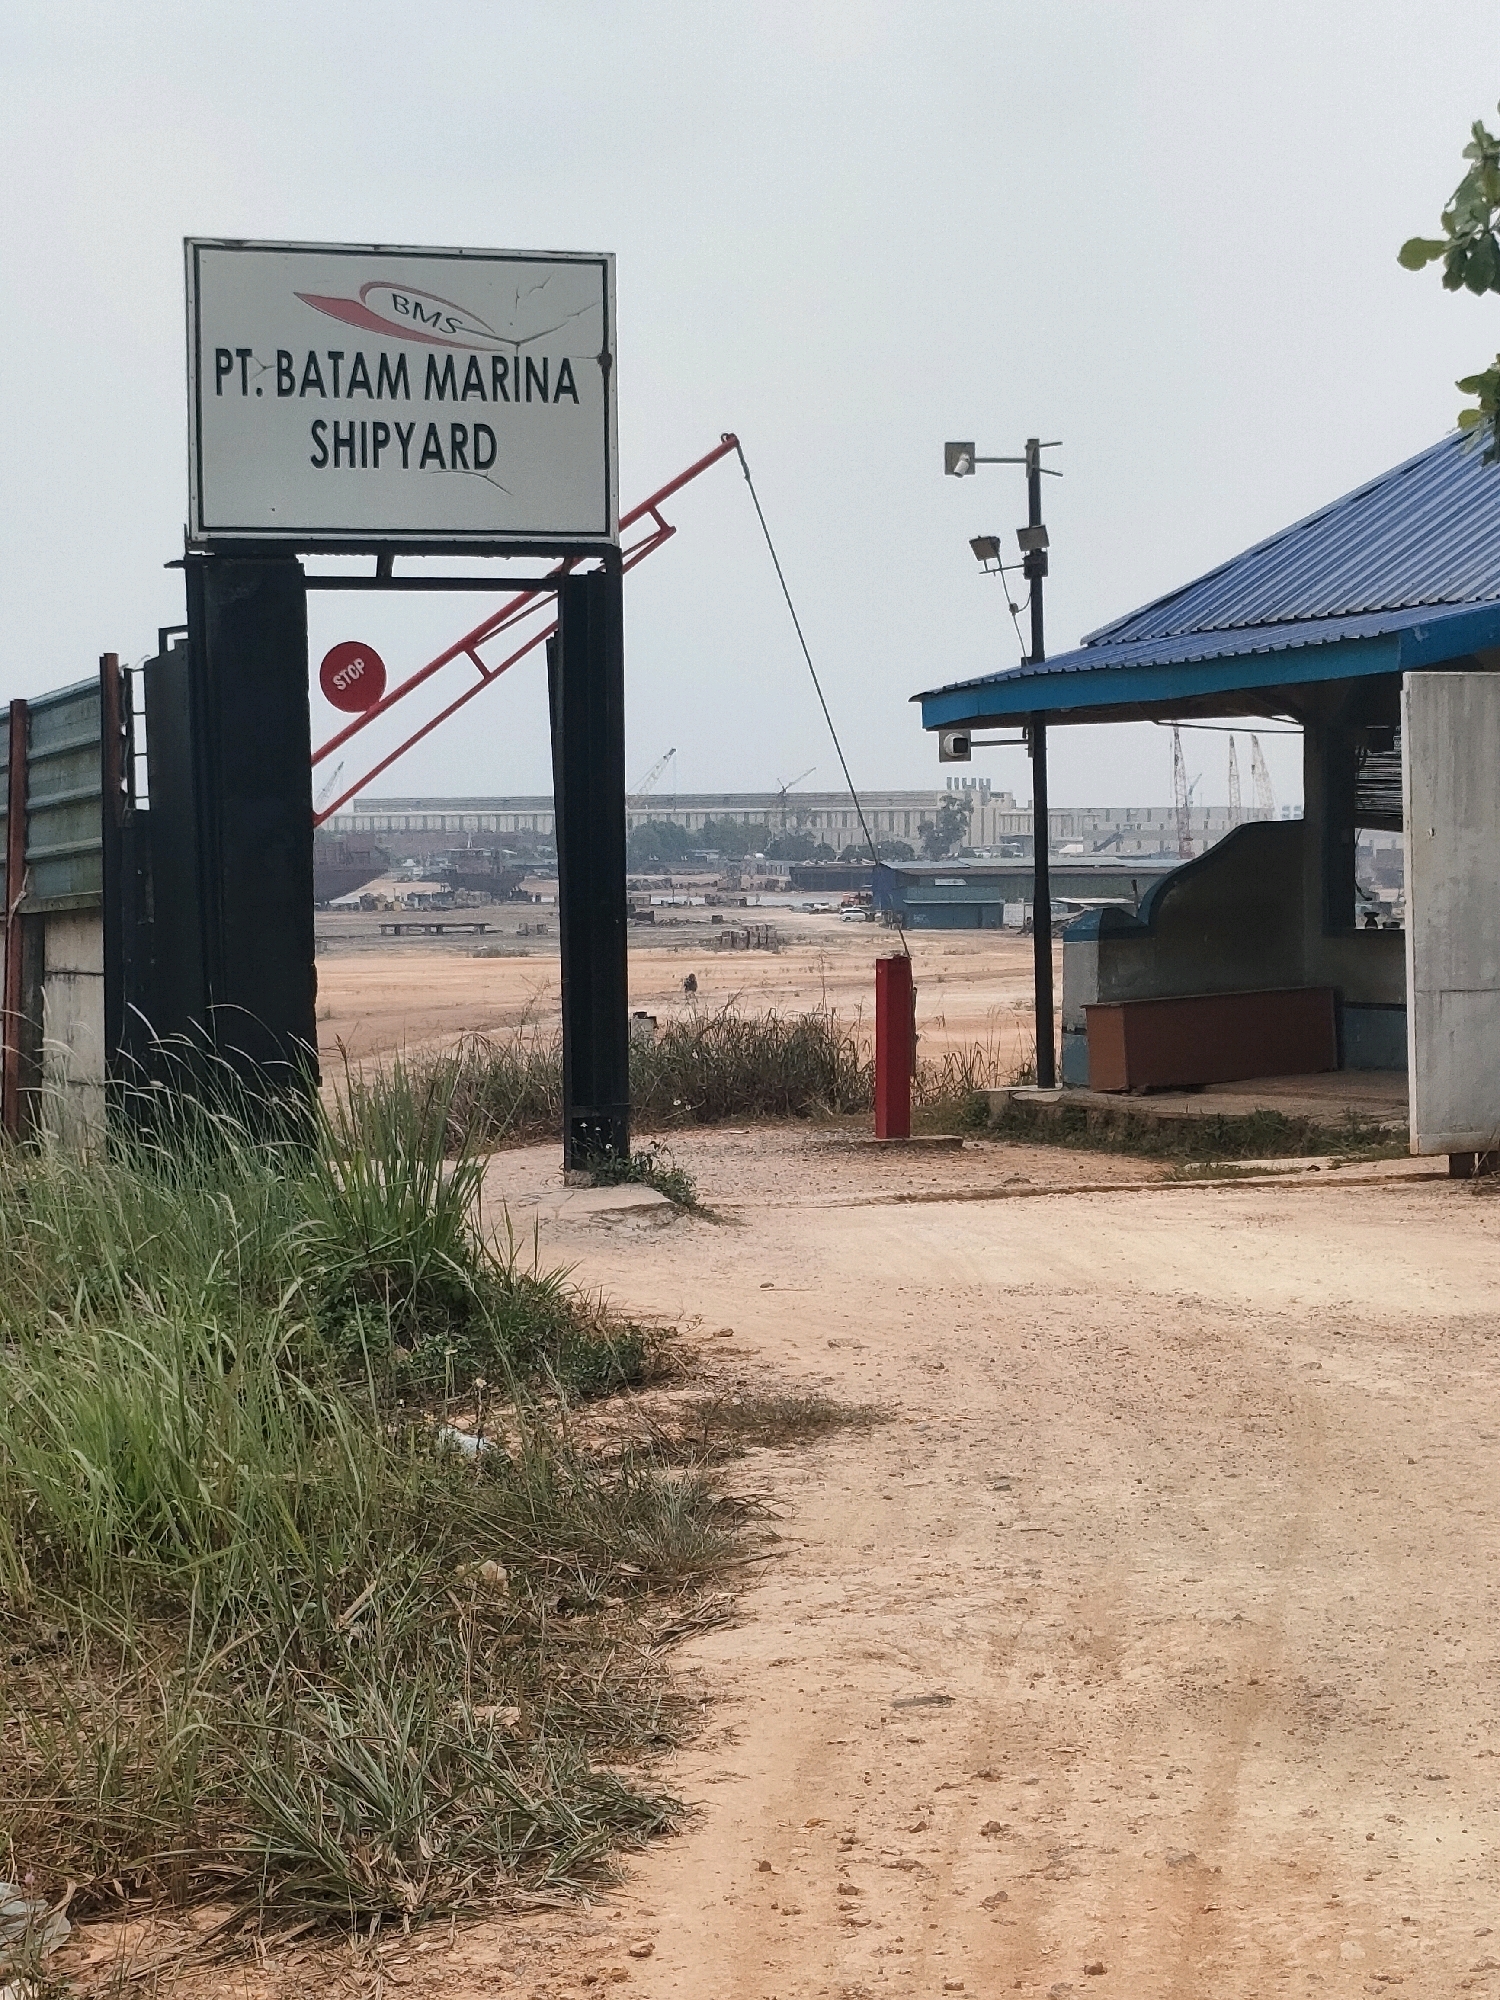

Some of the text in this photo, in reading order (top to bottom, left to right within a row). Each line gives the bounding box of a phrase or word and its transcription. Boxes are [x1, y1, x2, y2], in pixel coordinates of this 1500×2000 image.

[391, 293, 464, 335] BMS
[215, 348, 580, 404] PT. BATAM MARINA
[310, 419, 498, 470] SHIPYARD
[333, 657, 365, 690] STOP
